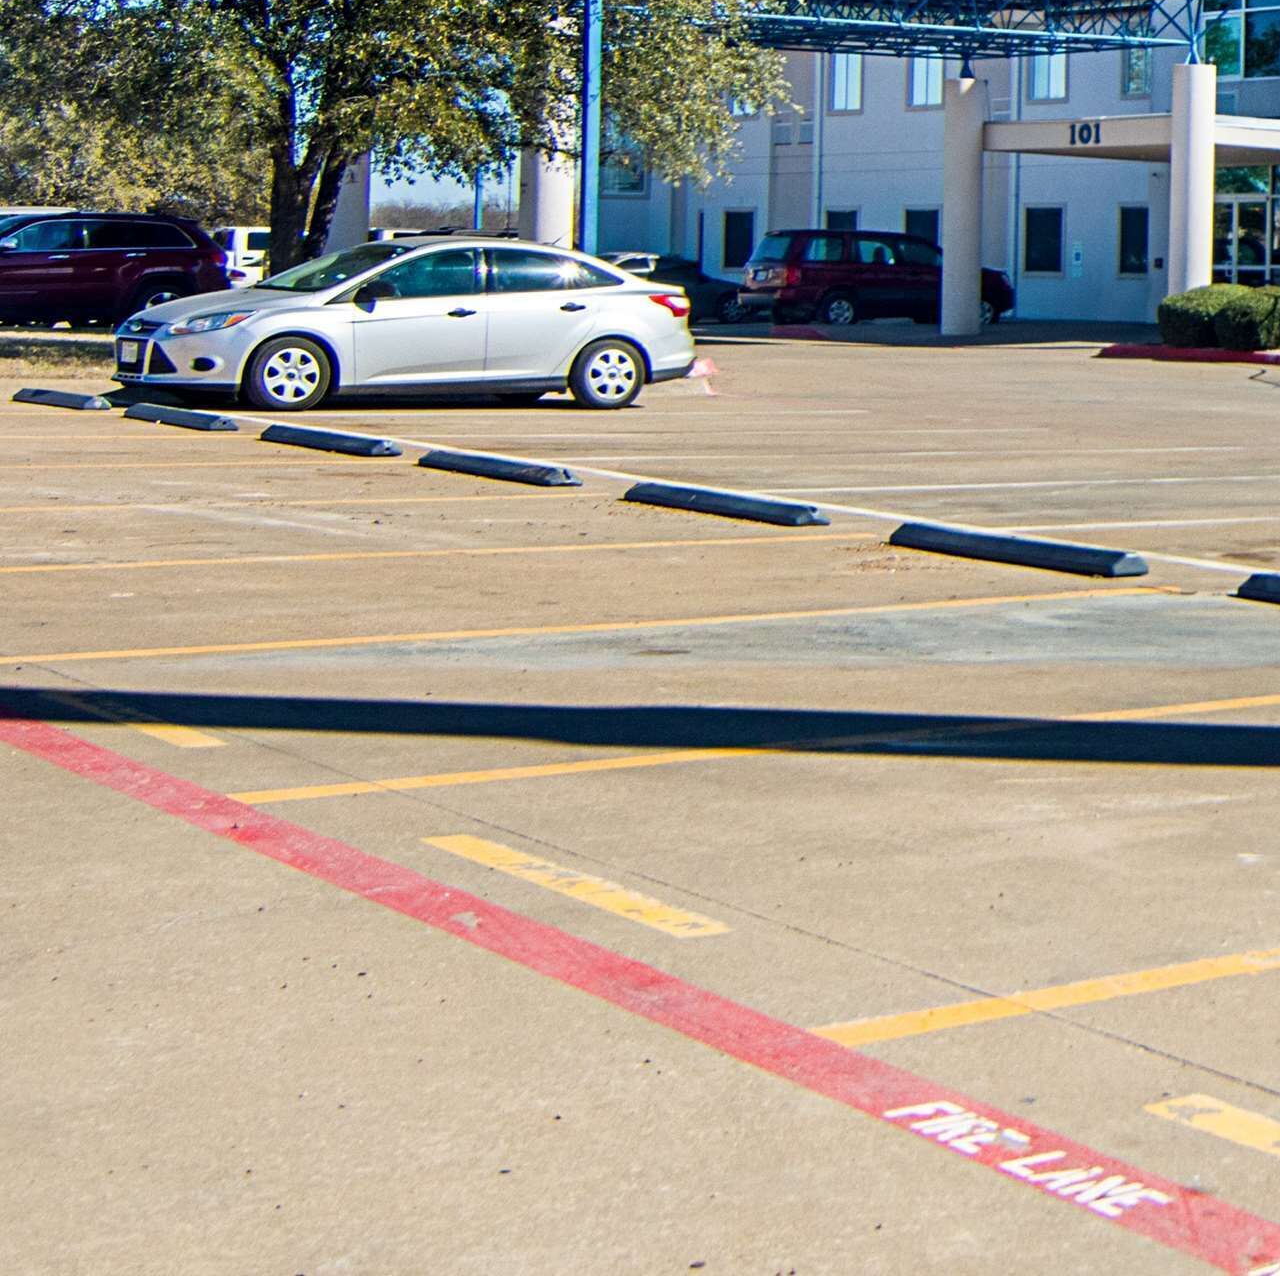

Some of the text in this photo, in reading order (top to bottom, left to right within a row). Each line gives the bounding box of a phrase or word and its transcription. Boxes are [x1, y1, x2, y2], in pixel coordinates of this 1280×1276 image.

[1069, 123, 1101, 145] 101
[883, 1100, 1174, 1218] FIRE LANE
